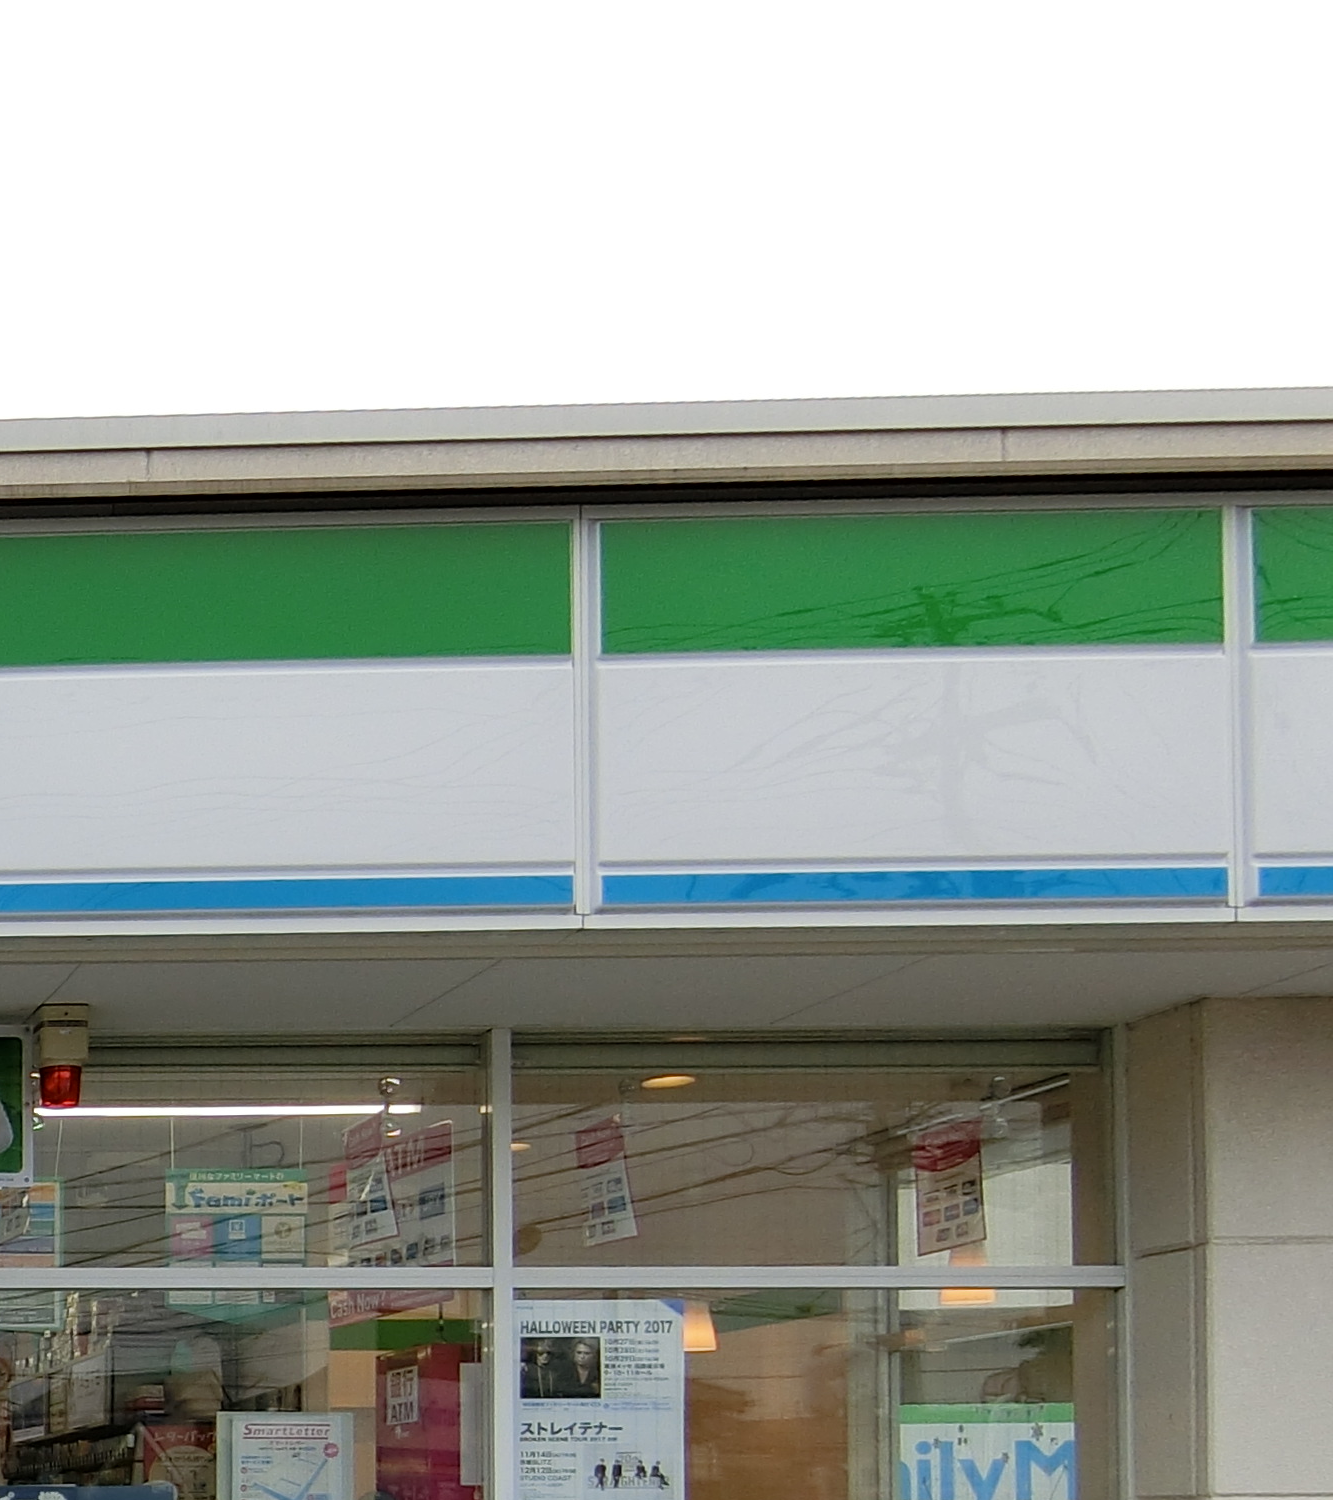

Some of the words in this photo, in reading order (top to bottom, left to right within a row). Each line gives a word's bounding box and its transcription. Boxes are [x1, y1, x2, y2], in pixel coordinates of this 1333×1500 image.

[520, 1320, 596, 1334] HALLOWEEN
[599, 1320, 640, 1334] PARTY
[644, 1320, 673, 1334] 2017
[390, 1402, 414, 1423] ATM
[243, 1424, 330, 1437] SmartLetter
[520, 1421, 623, 1435] ストレイテナー
